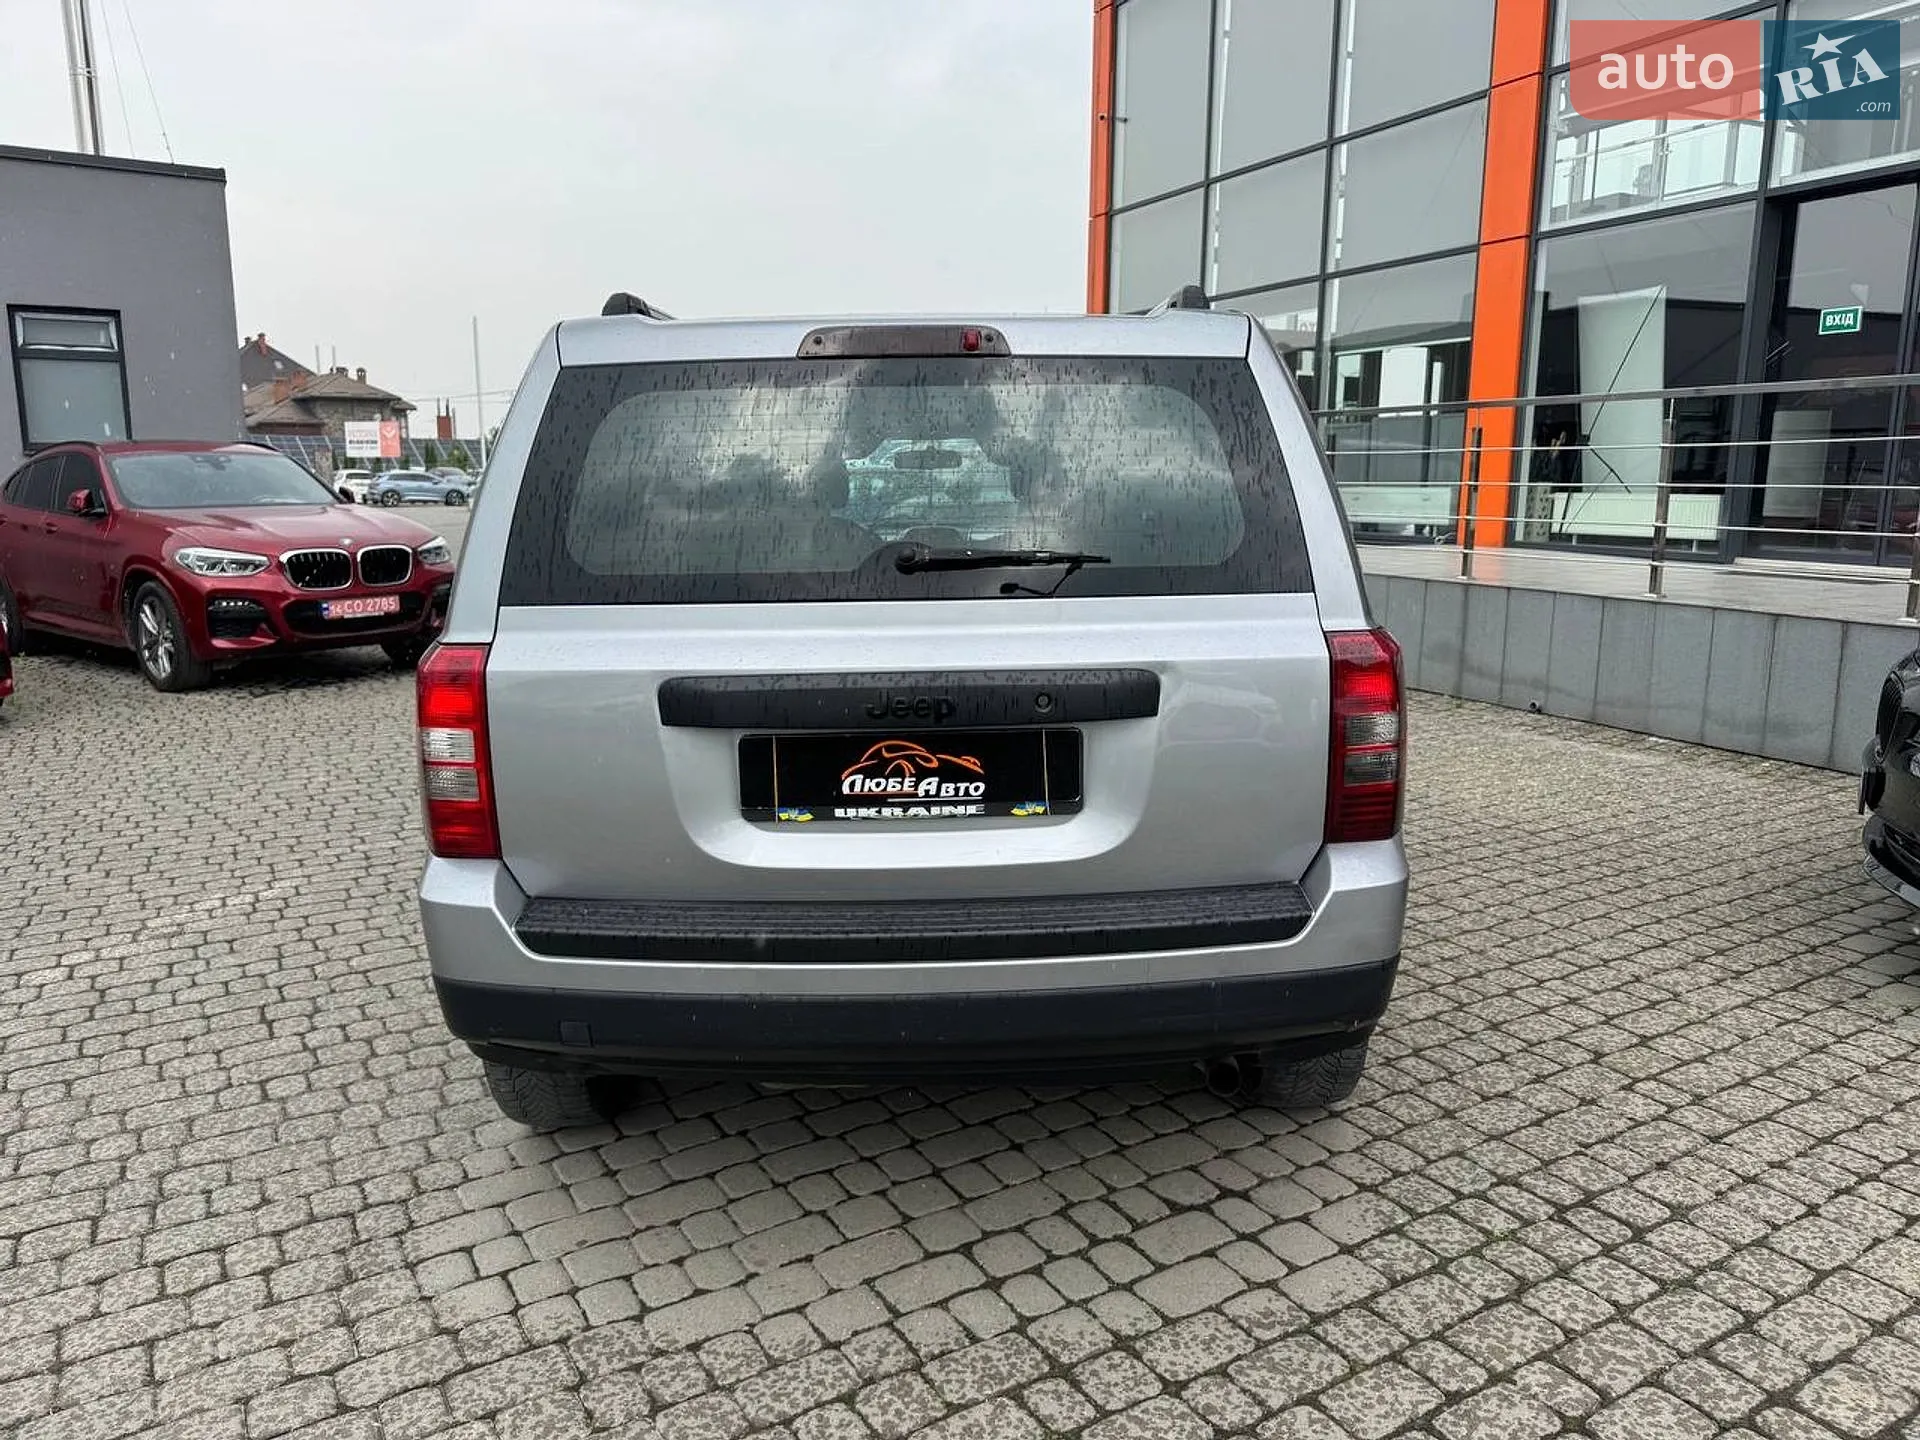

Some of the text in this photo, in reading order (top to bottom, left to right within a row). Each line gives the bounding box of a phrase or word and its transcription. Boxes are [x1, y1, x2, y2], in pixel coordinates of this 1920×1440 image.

[1825, 312, 1854, 328] ВХІД
[864, 687, 956, 724] Jeep
[834, 804, 985, 818] UKRAINE
